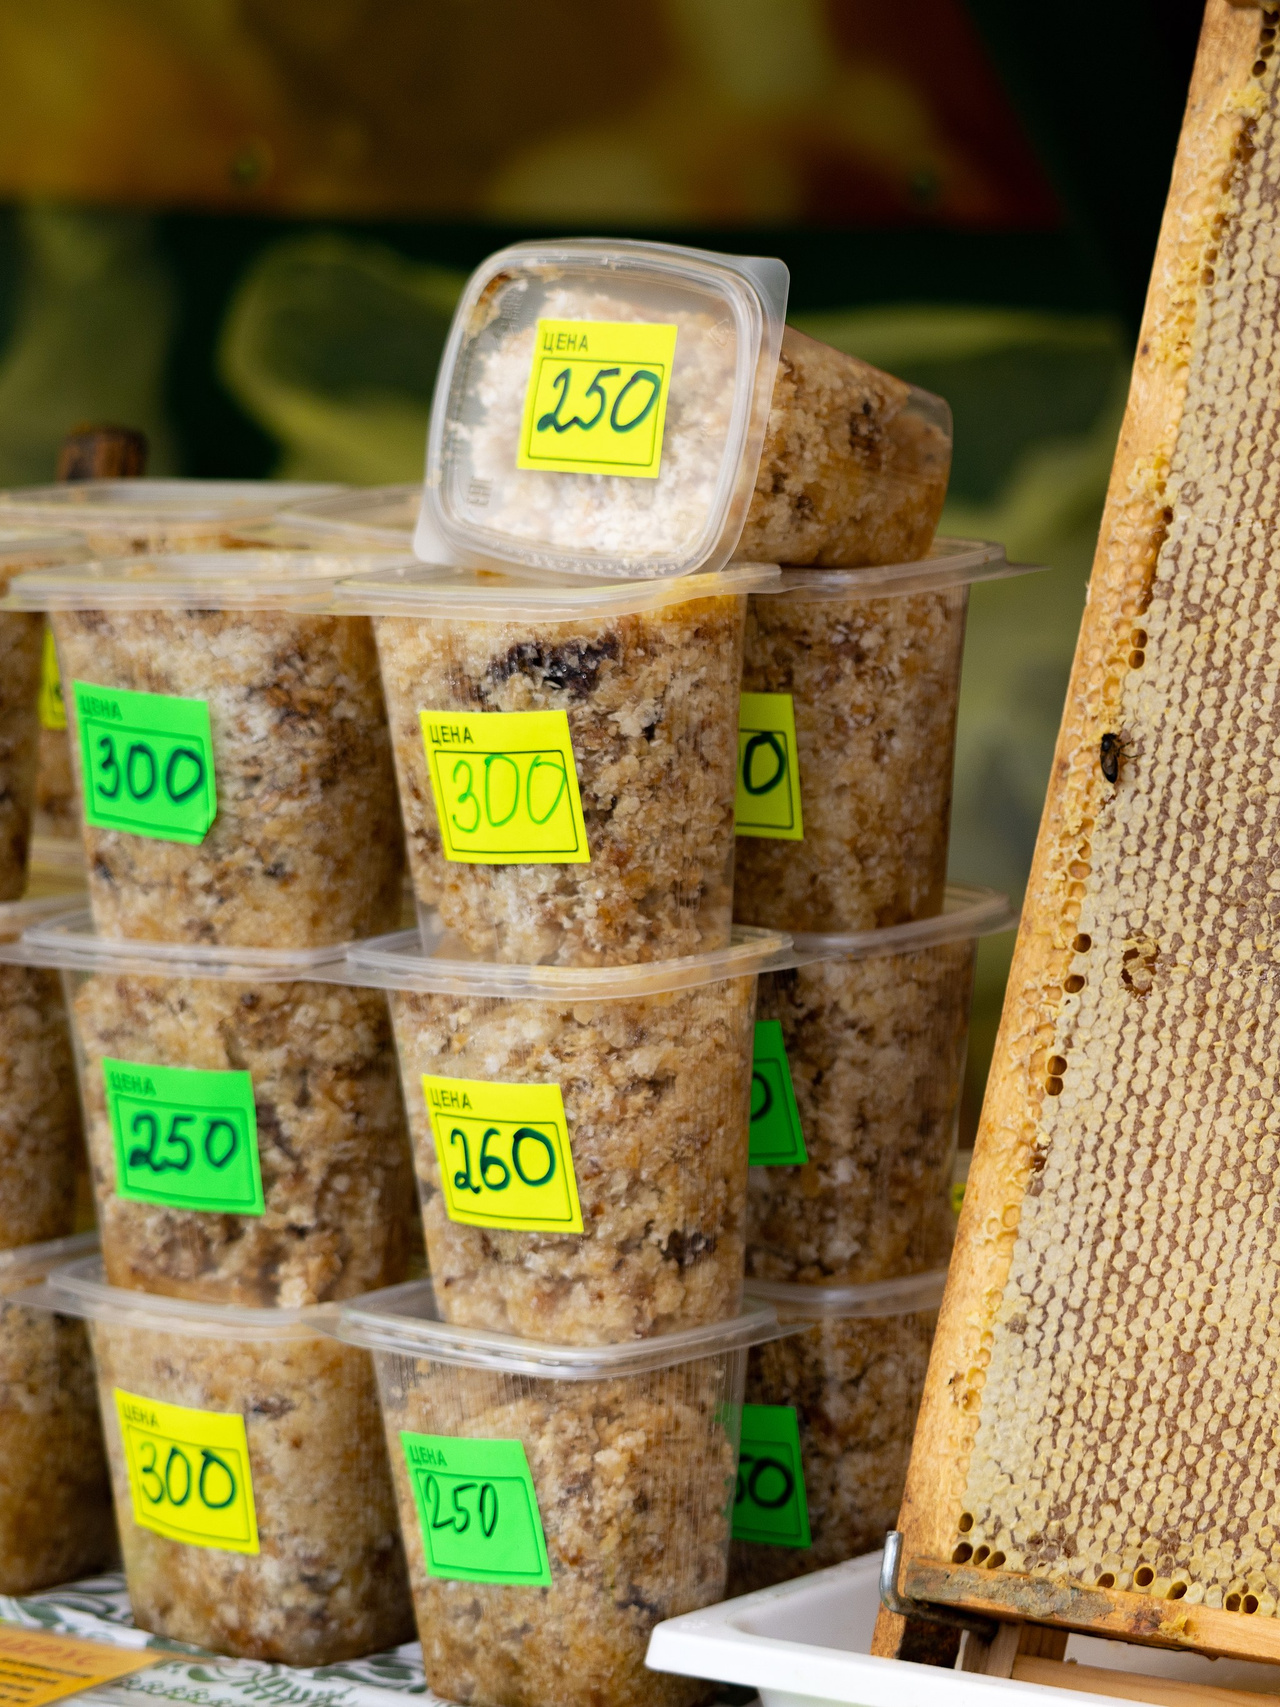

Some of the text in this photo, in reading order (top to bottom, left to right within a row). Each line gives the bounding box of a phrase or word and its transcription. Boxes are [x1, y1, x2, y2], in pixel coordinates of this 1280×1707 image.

[543, 332, 589, 354] ЦЕНА
[537, 367, 661, 434] 250
[80, 694, 123, 720] ЦЕНА
[430, 724, 474, 746] ЦЕНА
[96, 733, 205, 803] 300
[452, 753, 566, 833] 300
[111, 1071, 156, 1096] ЦЕНА
[430, 1087, 472, 1110] ЦЕНА
[128, 1113, 241, 1172] 250
[450, 1127, 556, 1194] 260
[122, 1402, 160, 1428] ЦЕНА
[139, 1441, 237, 1509] 300
[409, 1444, 447, 1467] ЦЕНА
[425, 1474, 498, 1538] 250
